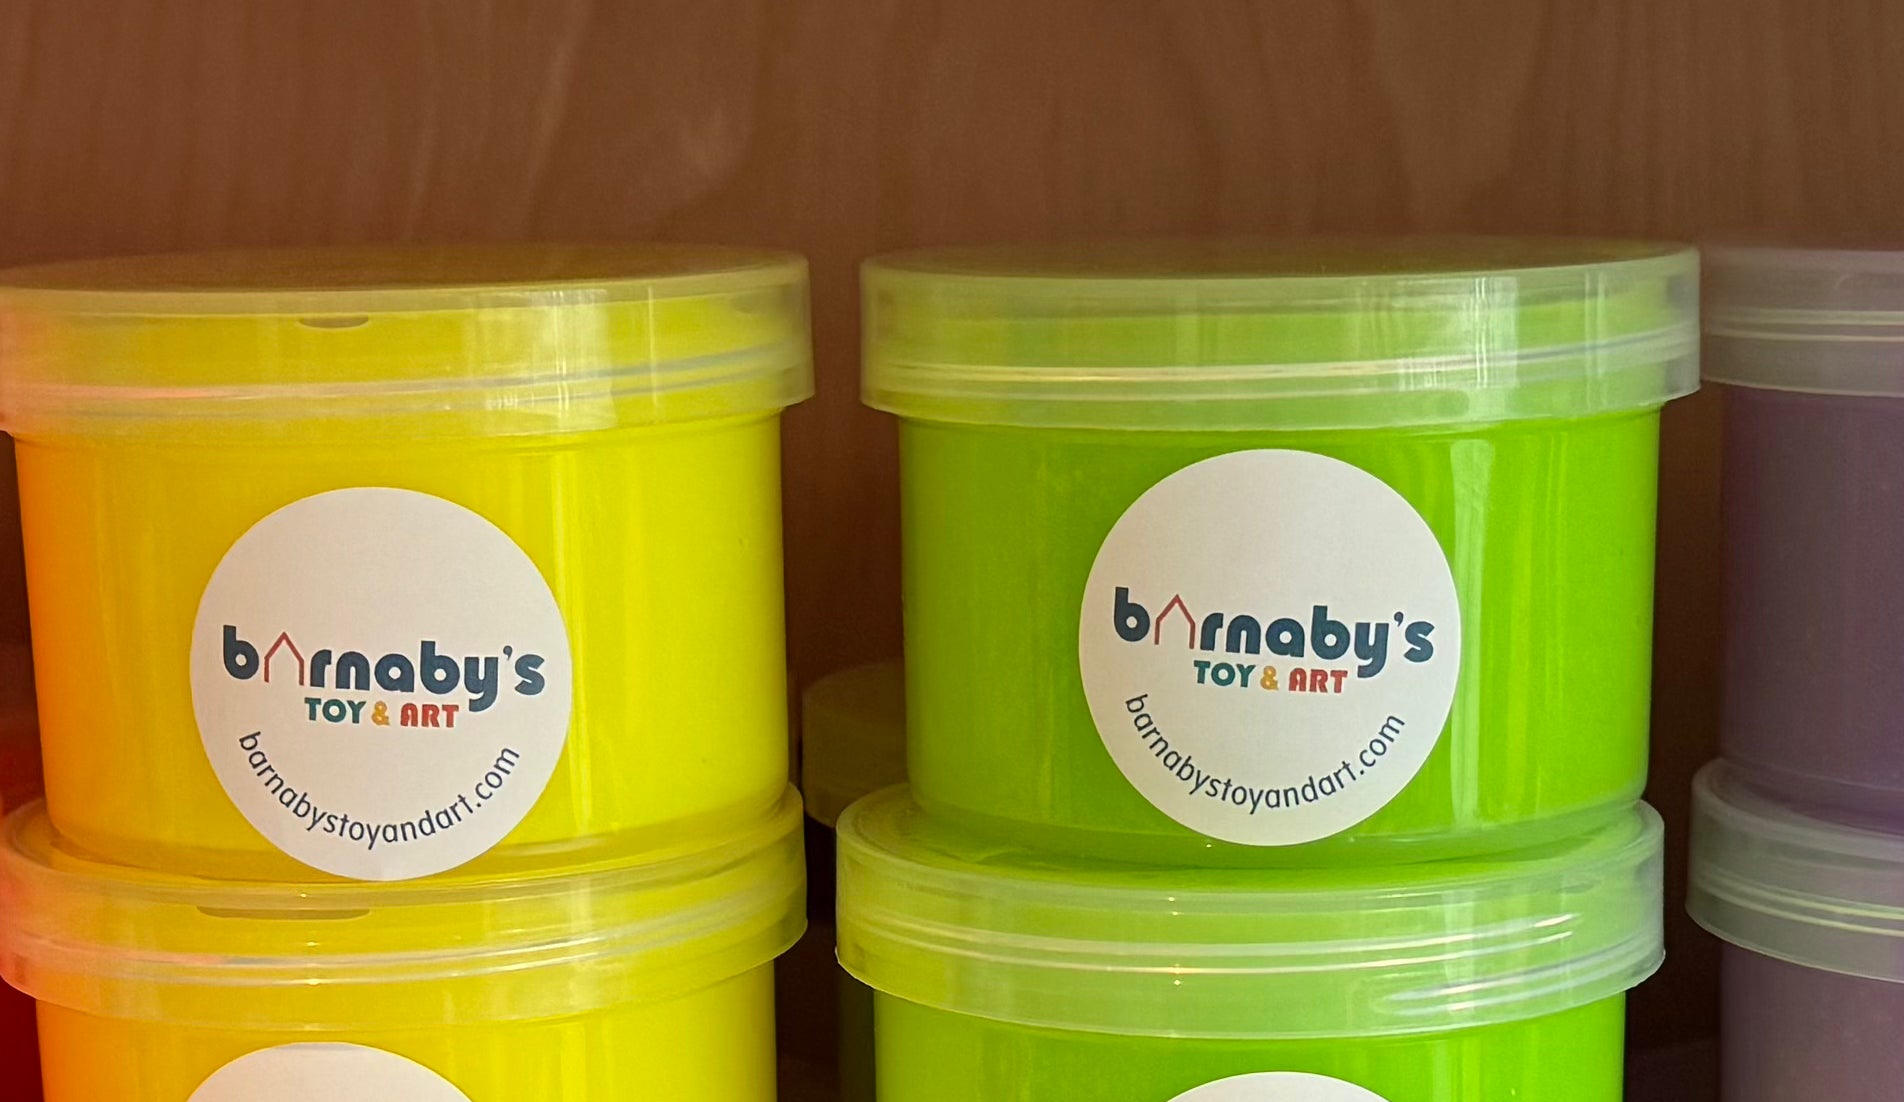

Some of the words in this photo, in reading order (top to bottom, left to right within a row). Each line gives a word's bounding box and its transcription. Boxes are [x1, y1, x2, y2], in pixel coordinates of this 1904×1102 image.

[302, 695, 367, 724] TOY
[370, 702, 391, 726] &
[399, 702, 461, 729] ART
[1192, 658, 1258, 688] TOY
[1261, 664, 1280, 689] &
[1287, 665, 1349, 694] ART
[236, 729, 521, 850] barnabystoyandart.com
[1122, 691, 1408, 815] barnabystoyandart.com
